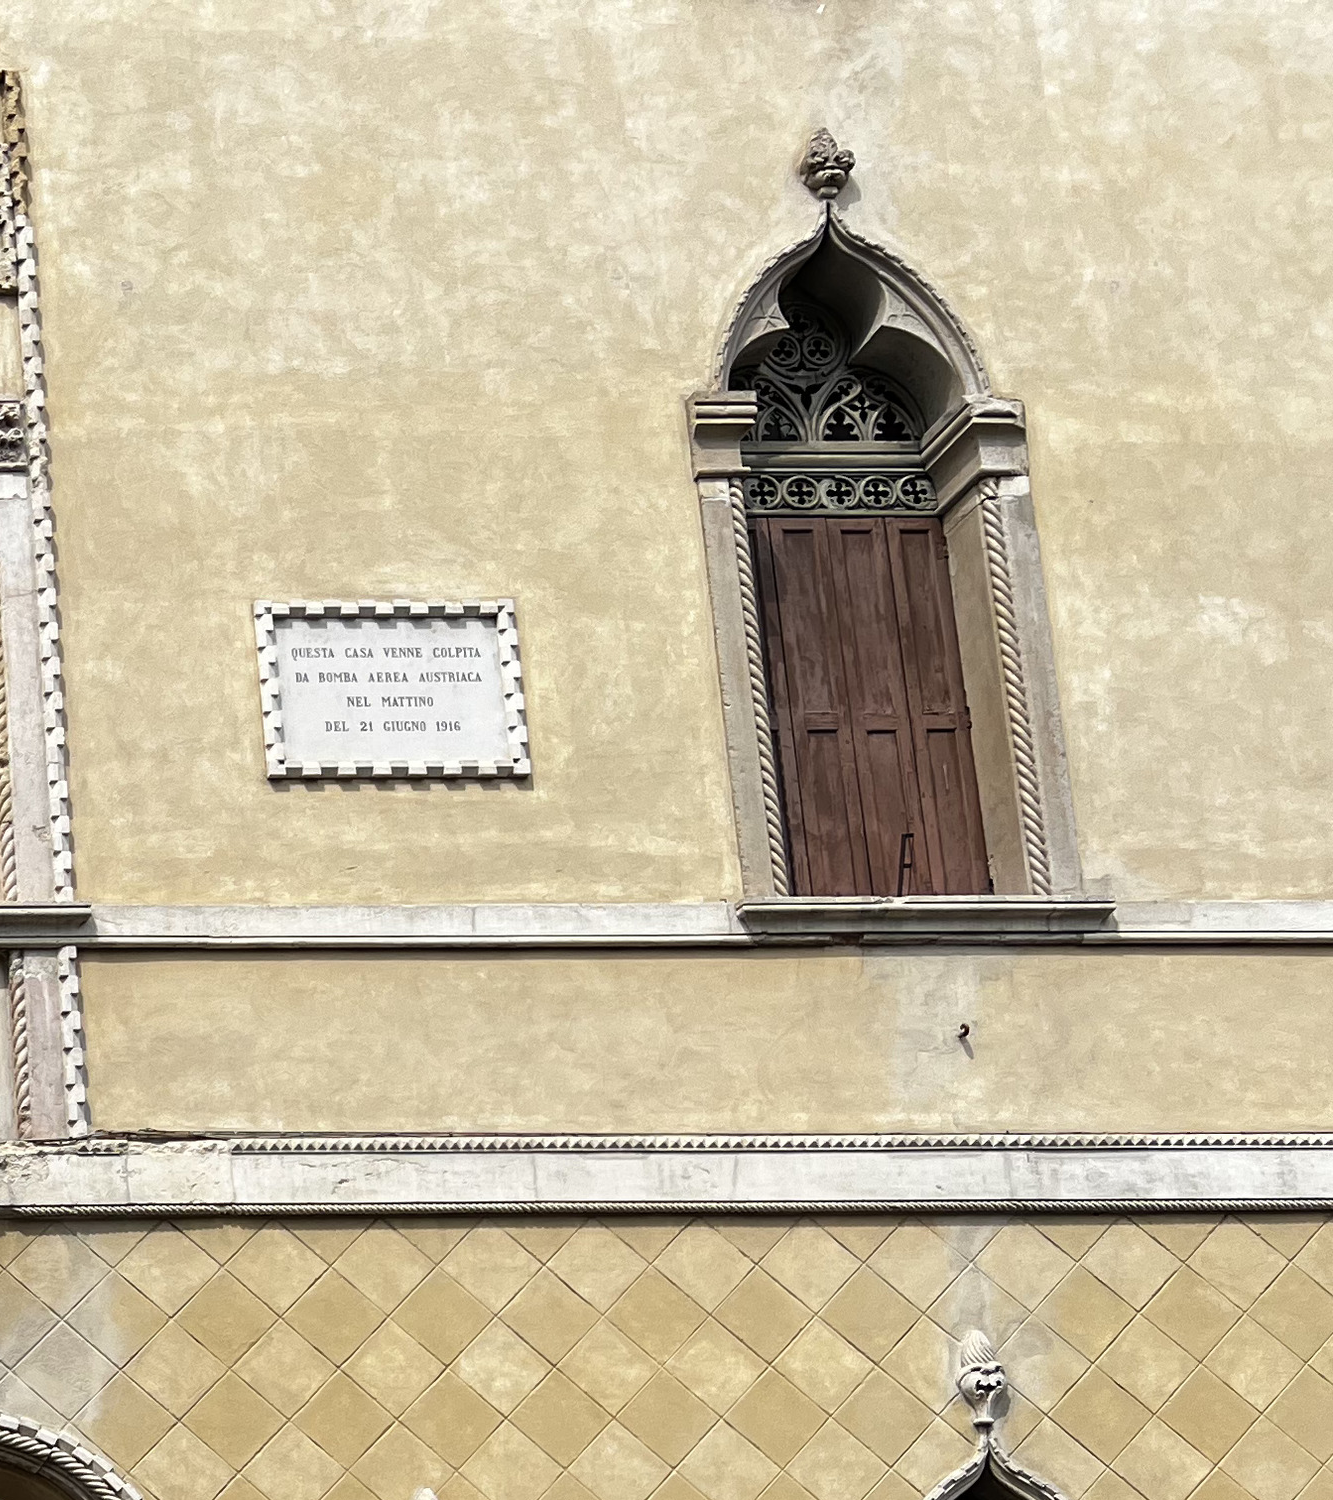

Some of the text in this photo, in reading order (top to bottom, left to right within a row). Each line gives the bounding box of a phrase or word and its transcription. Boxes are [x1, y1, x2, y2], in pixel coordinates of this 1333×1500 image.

[291, 648, 481, 660] QUESTA CASA VENNE COLPITA
[295, 672, 482, 683] DA BOMBA AEREA AUSTRIACA
[347, 696, 433, 707] NEL MATTINO
[325, 721, 461, 732] DEL 21 GIUGNO 1916
